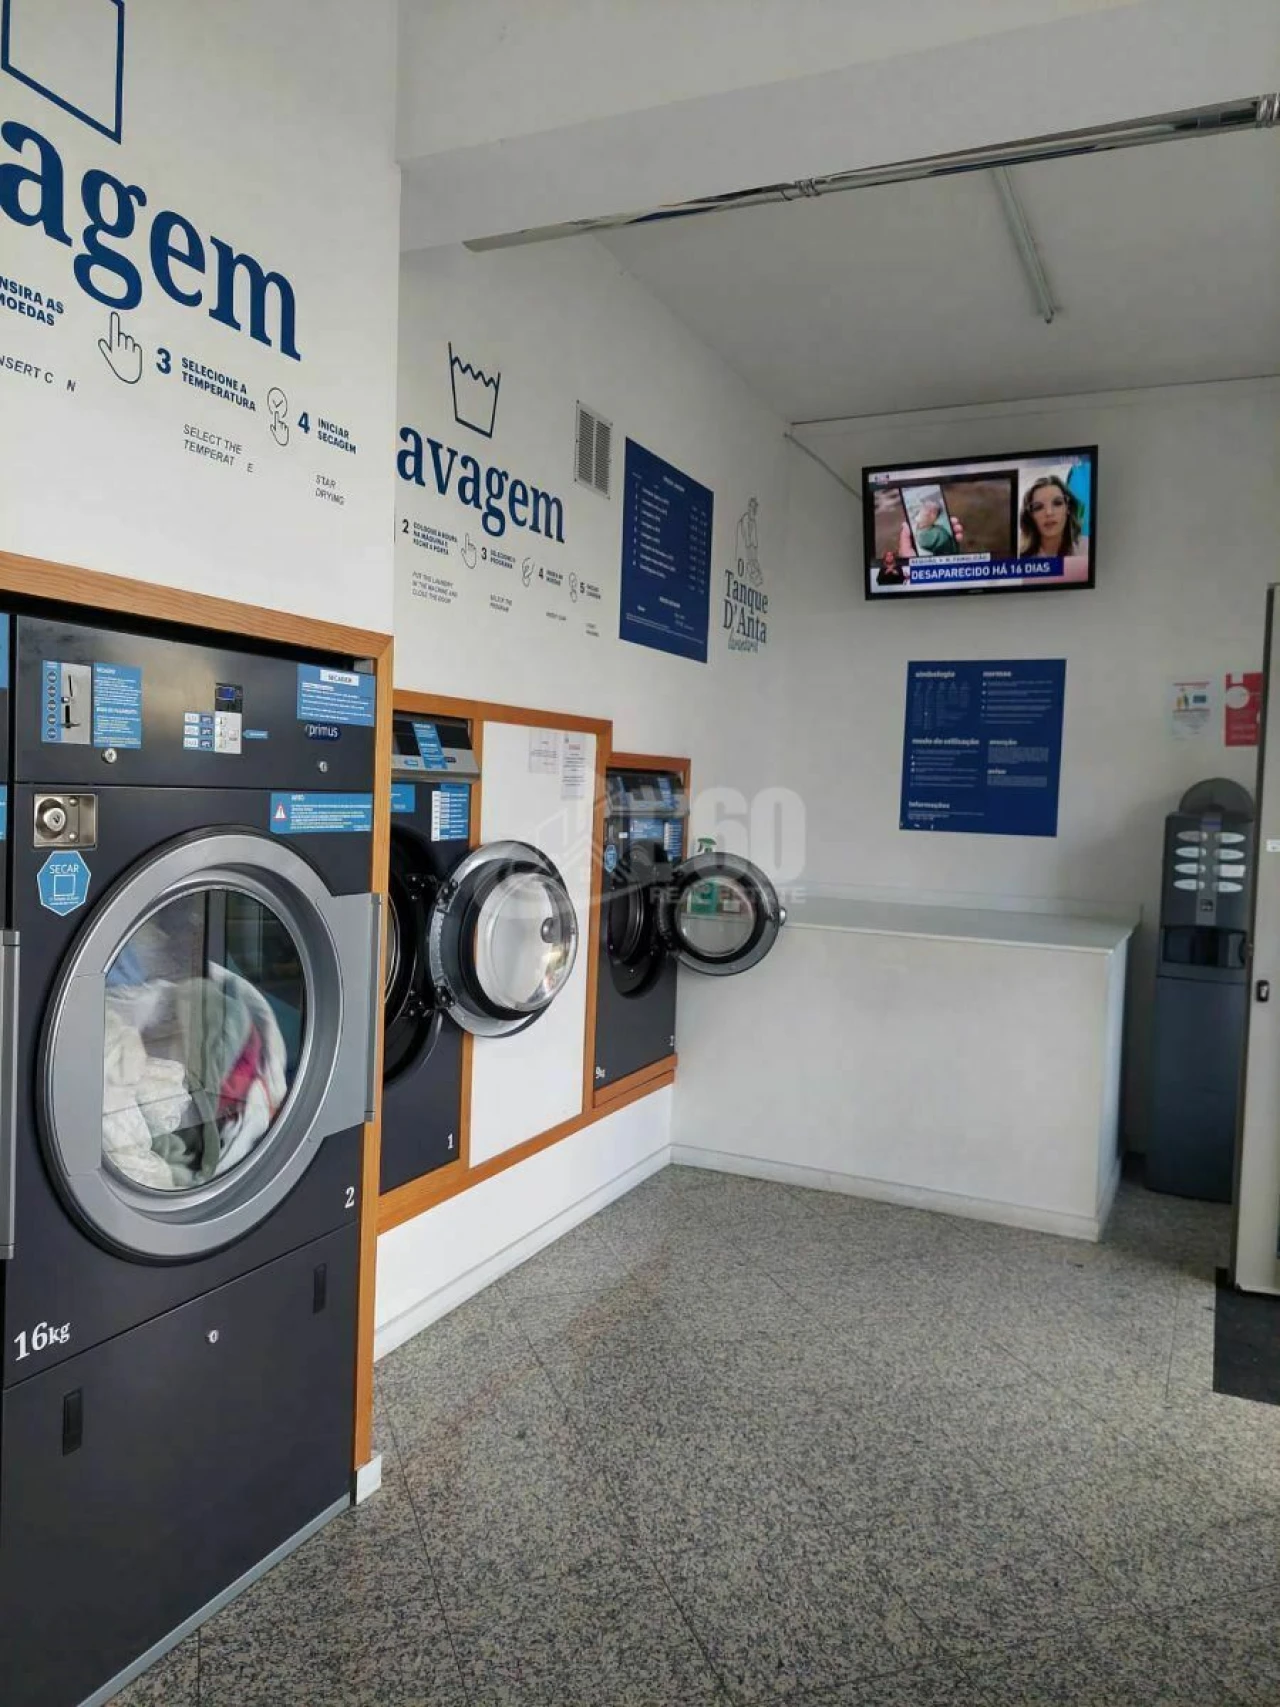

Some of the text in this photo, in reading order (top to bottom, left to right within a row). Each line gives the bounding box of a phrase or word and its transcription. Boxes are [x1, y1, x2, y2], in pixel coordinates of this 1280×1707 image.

[46, 298, 64, 315] AS
[155, 347, 172, 374] 3
[181, 357, 247, 394] SELECIONE A
[181, 371, 256, 412] TEMPERATURA
[298, 411, 311, 434] 4
[318, 417, 350, 439] INICIAR
[183, 424, 243, 455] SELECT THE
[317, 430, 357, 455] SECAGEM
[396, 426, 565, 544] avagem
[402, 518, 409, 534] 2
[481, 547, 487, 560] 3
[737, 558, 745, 577] O
[911, 562, 1050, 581] DESAPARECIDO HÁ 16 DIAS
[725, 569, 769, 614] Tanque
[723, 599, 767, 644] D'Anta
[309, 724, 338, 738] primus
[49, 864, 79, 874] SECAR
[447, 1133, 453, 1150] 1
[344, 1186, 355, 1209] 2
[13, 1321, 71, 1361] 16kg
